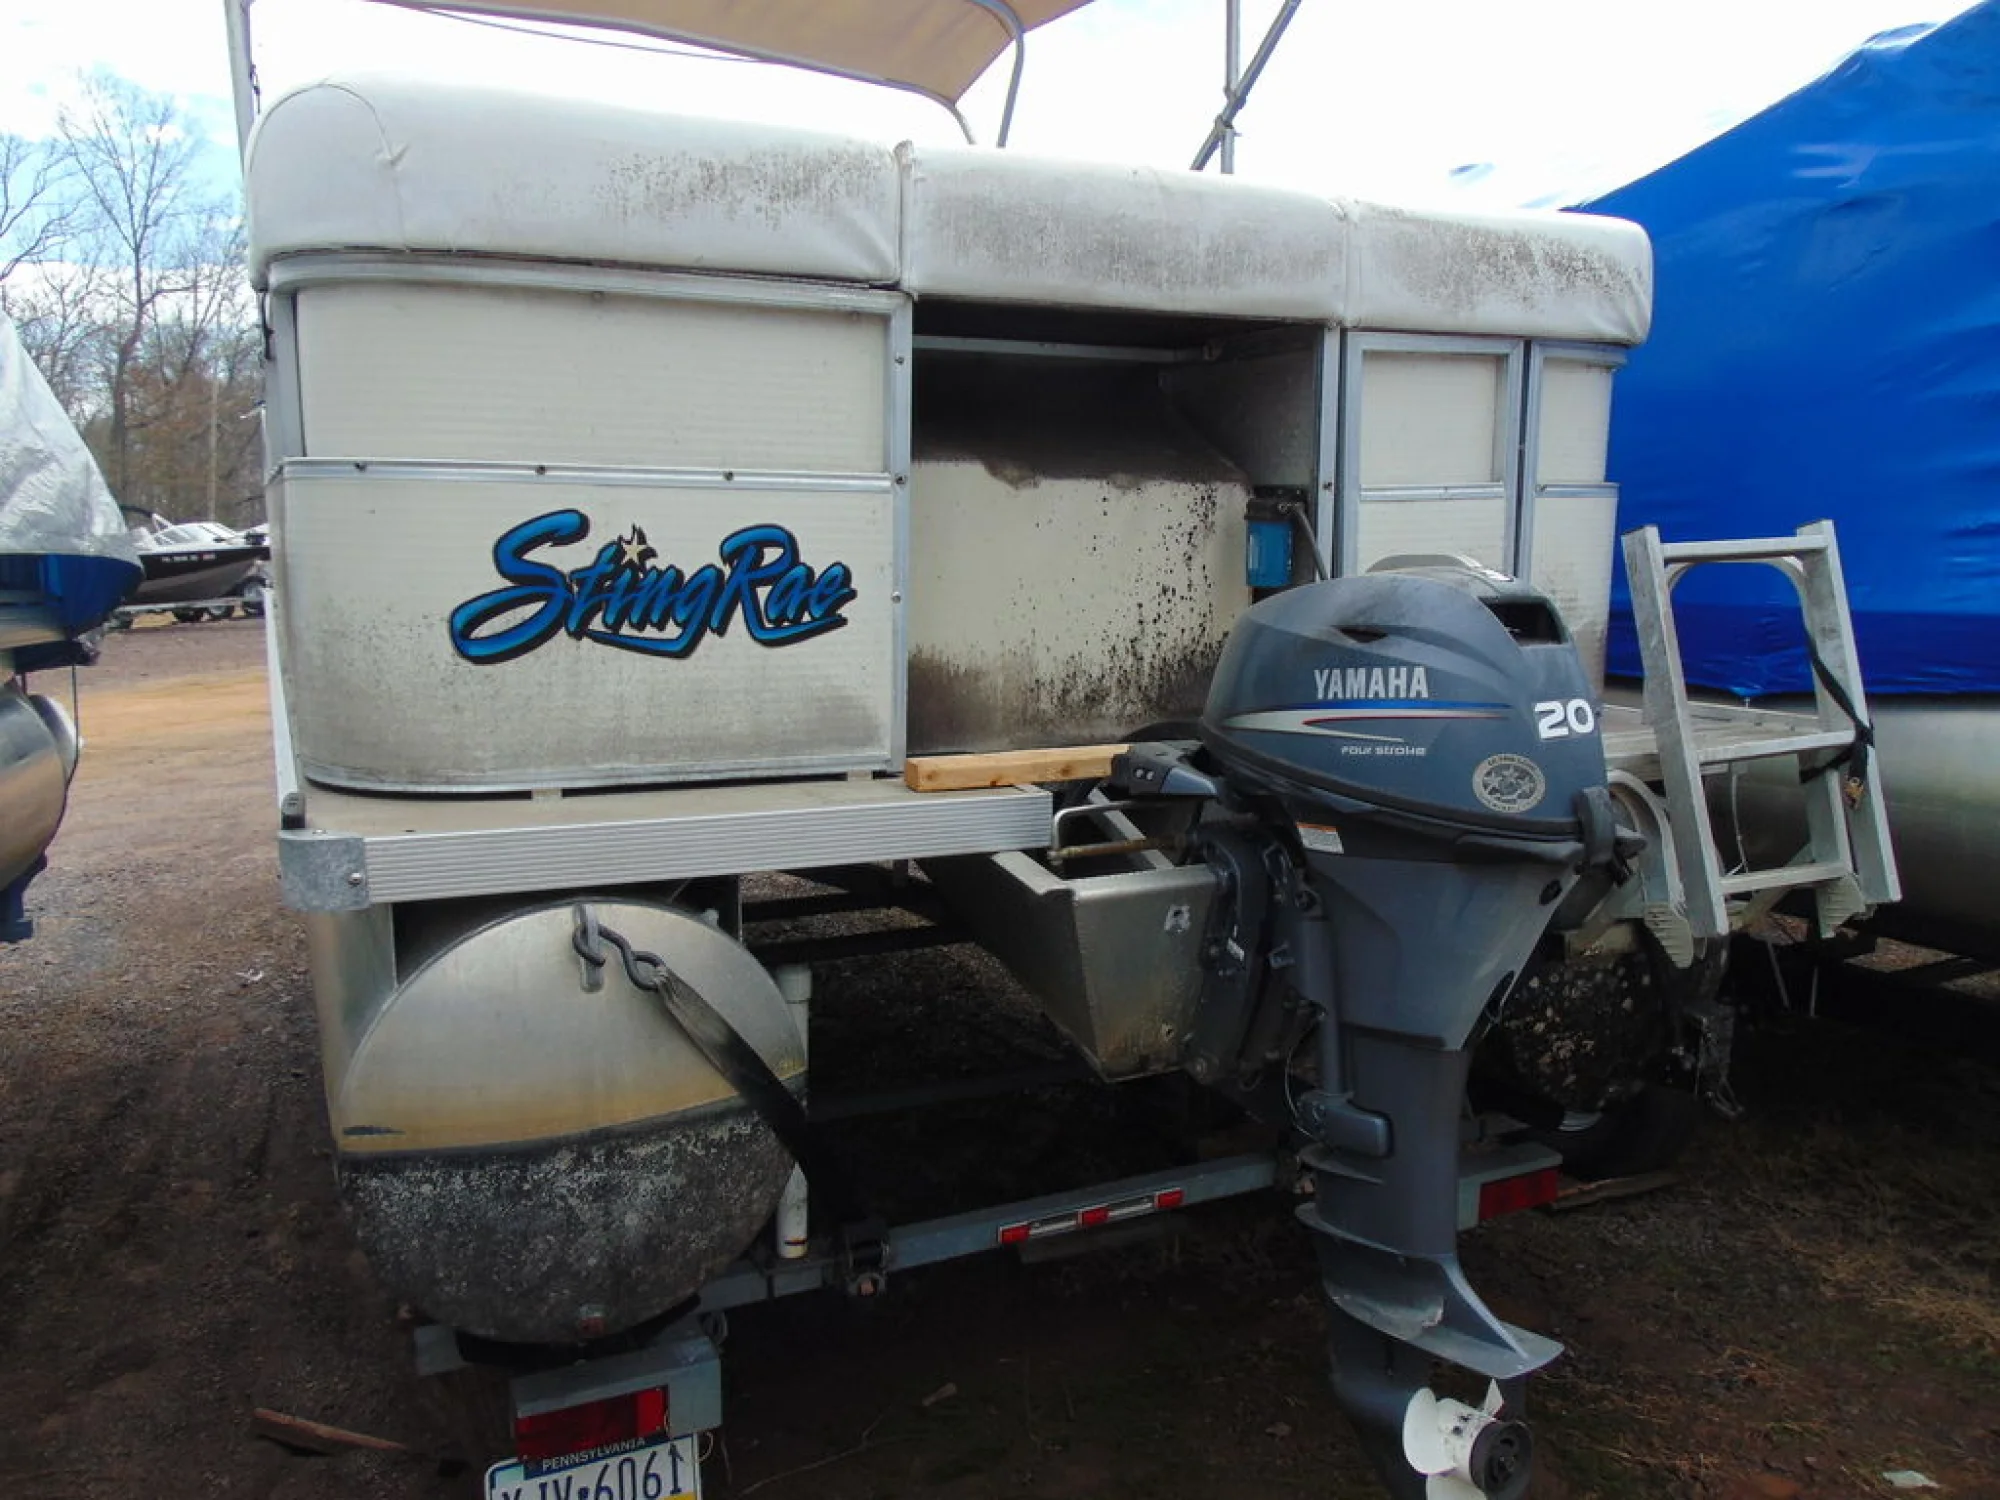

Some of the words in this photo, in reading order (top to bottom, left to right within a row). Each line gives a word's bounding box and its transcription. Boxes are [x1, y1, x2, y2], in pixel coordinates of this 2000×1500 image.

[1314, 666, 1429, 699] YAMAHA
[1534, 698, 1595, 740] 20
[541, 1436, 646, 1472] PENNSYLVANIA
